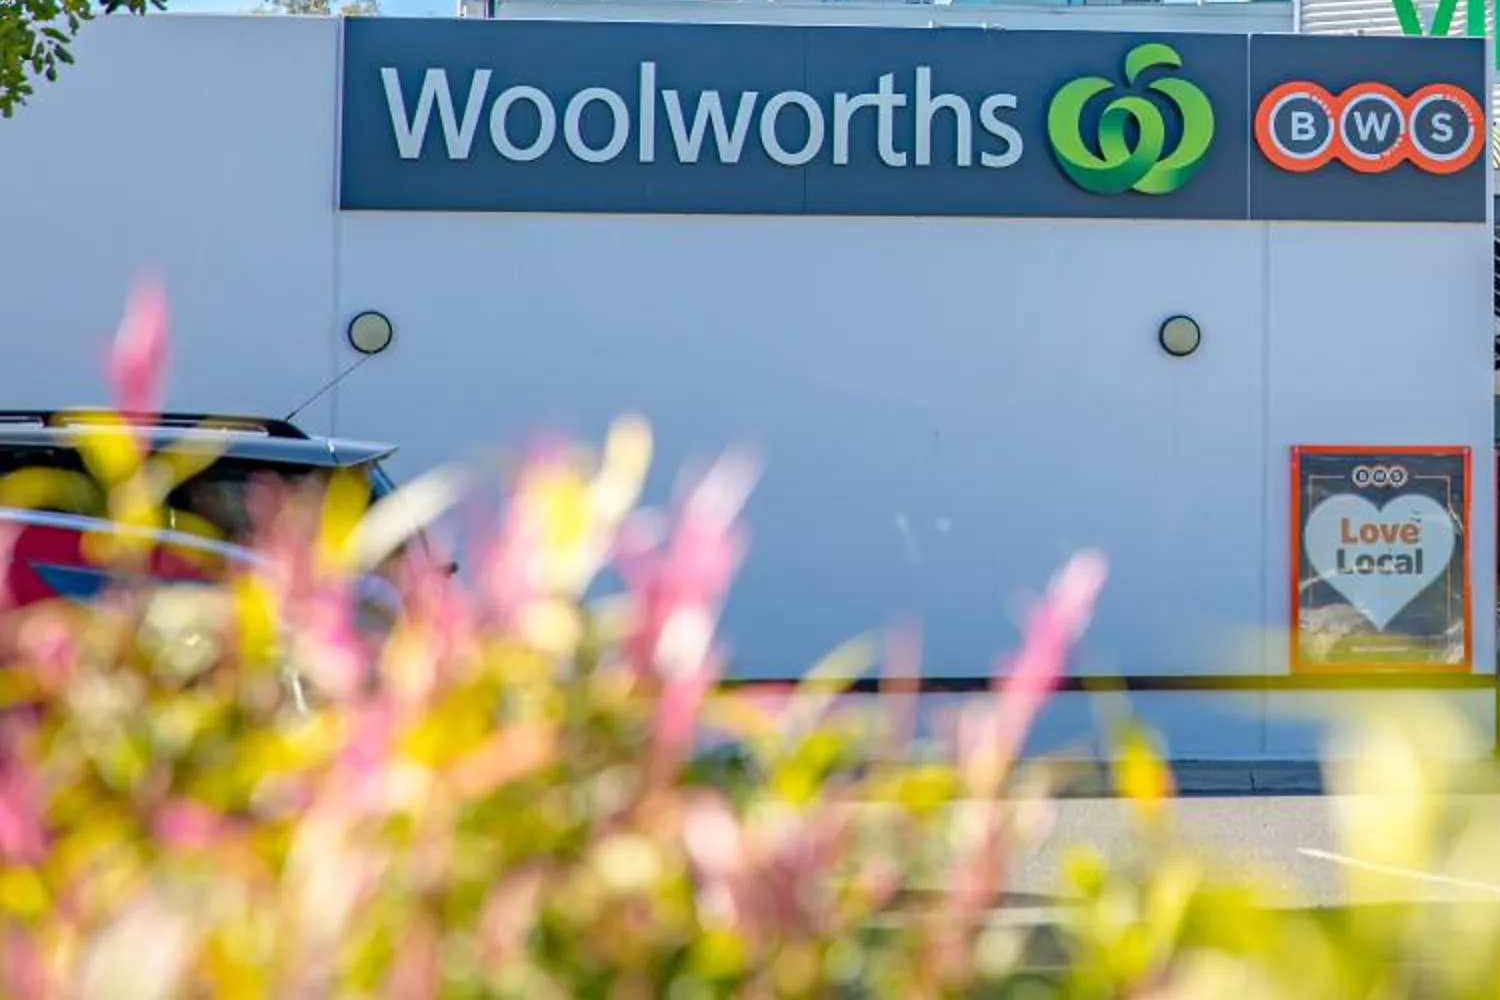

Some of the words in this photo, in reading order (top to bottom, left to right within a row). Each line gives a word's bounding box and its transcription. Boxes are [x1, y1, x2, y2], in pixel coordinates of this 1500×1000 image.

[380, 61, 1024, 169] Woolworths
[1291, 111, 1454, 143] BWS
[1341, 518, 1420, 544] Love
[1337, 548, 1423, 575] Local
